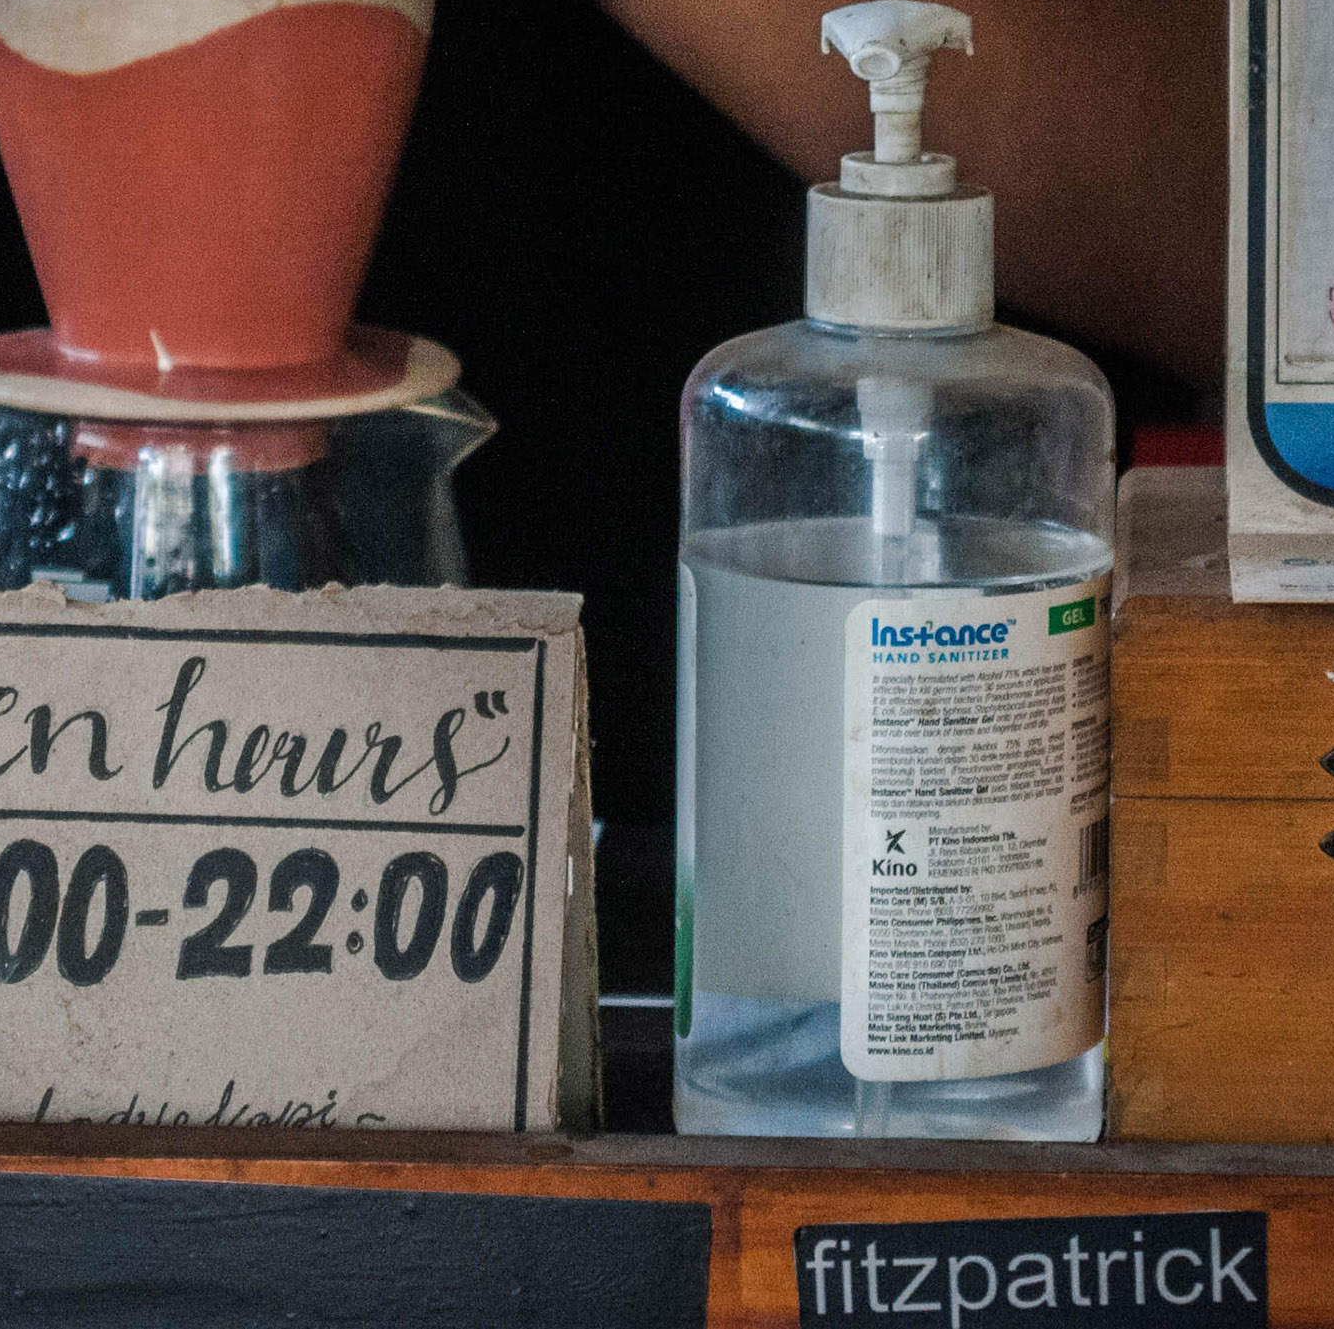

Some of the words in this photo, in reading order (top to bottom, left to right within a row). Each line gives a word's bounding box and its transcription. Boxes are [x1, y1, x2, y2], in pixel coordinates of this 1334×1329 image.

[1062, 608, 1086, 626] GEL
[873, 652, 921, 664] HAND
[927, 648, 1009, 663] SANITIZER
[918, 716, 940, 727] Hand
[943, 715, 978, 725] Sanitizer
[981, 714, 995, 724] Gel
[915, 788, 936, 797] Hand
[929, 837, 939, 846] PT
[941, 837, 960, 845] Kino
[962, 834, 1000, 845] Indonesia
[872, 859, 918, 877] Kino
[870, 886, 958, 896] Imported/Distributed
[870, 897, 889, 906] Kino
[891, 897, 911, 906] Care
[870, 918, 888, 926] Kino
[890, 918, 934, 927] Consumer
[869, 950, 888, 958] Kino
[891, 949, 926, 958] Vietnam
[927, 948, 966, 959] Company
[869, 971, 888, 979] Kino
[890, 970, 910, 979] Care
[912, 969, 955, 979] Consumer
[869, 981, 894, 990] Malee
[897, 981, 916, 990] Kino
[918, 979, 960, 991] (Thailand)
[868, 1013, 884, 1021] Lim
[886, 1012, 911, 1022] Siang
[913, 1011, 933, 1021] Huat
[868, 1034, 886, 1043] New
[889, 1033, 907, 1042] Link
[910, 1033, 953, 1044] Marketing
[868, 1046, 934, 1055] www.kino.co.id
[805, 1227, 1259, 1329] fitzpatrick
